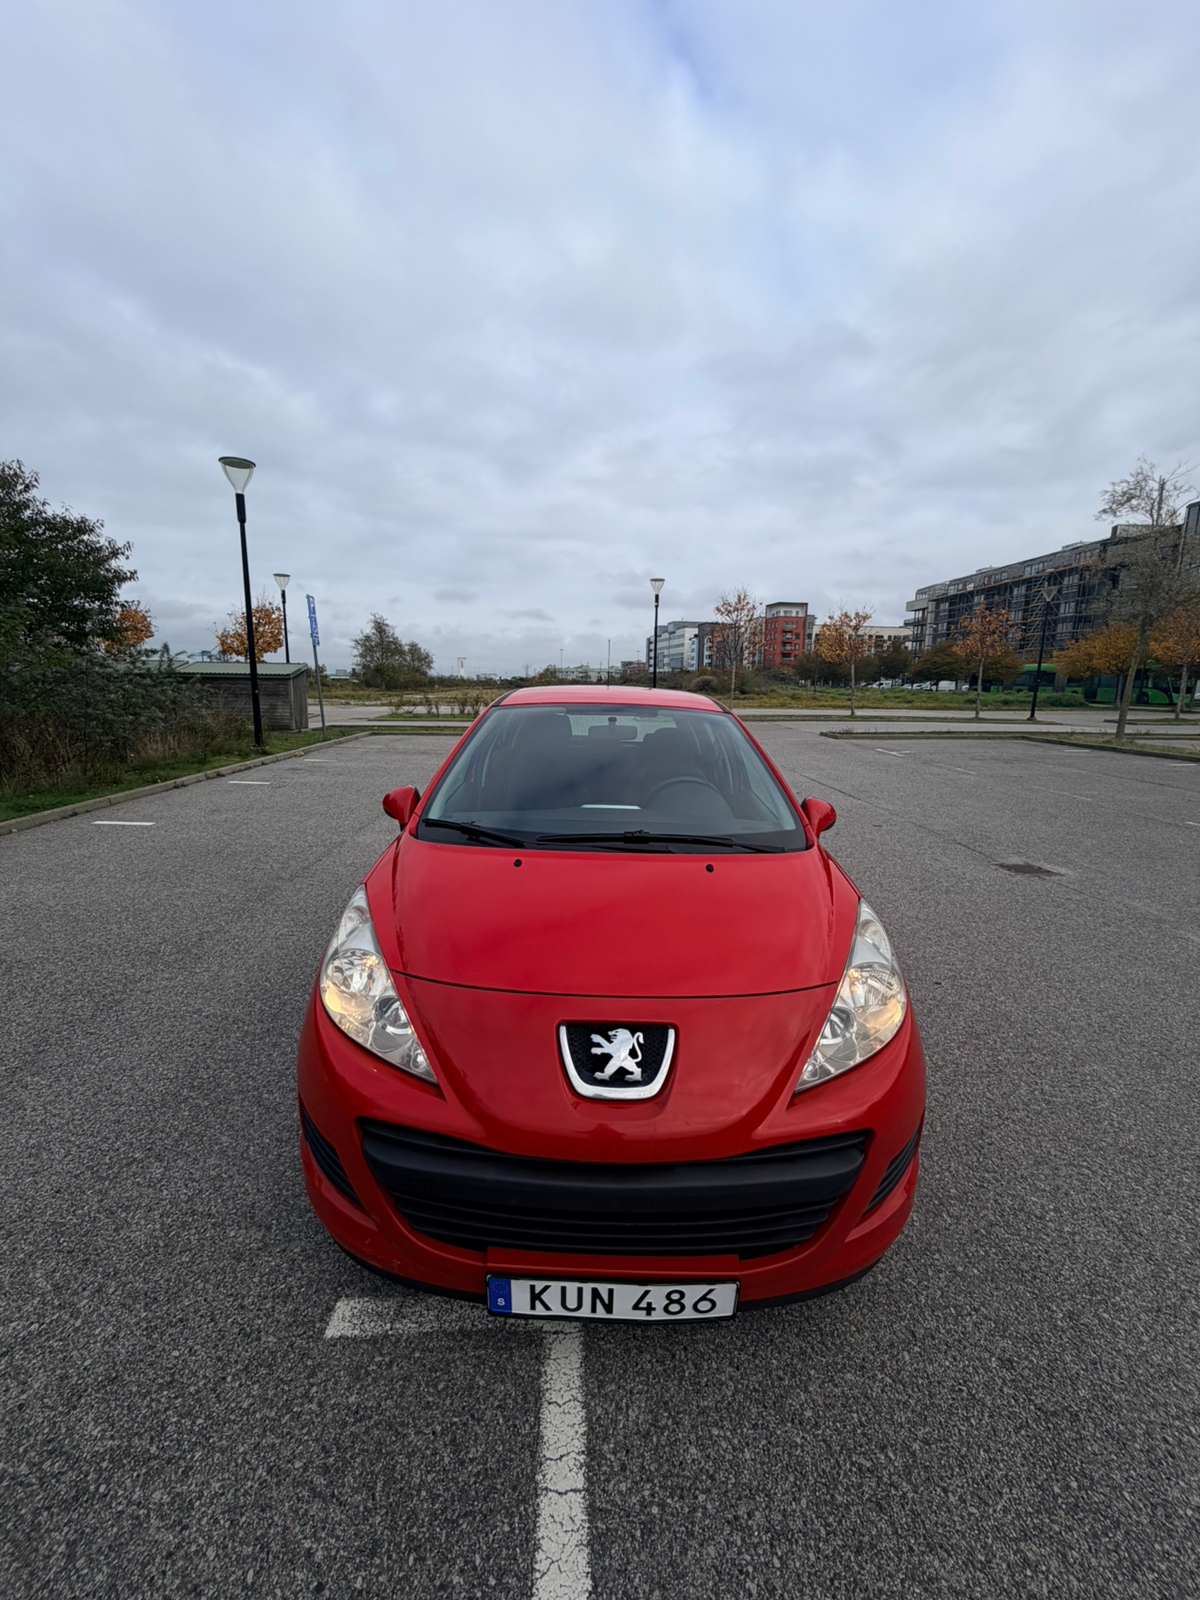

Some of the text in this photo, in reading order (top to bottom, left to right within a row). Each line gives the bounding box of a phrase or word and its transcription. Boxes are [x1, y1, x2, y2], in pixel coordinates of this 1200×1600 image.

[497, 1297, 505, 1307] S
[529, 1284, 717, 1316] KUN 486
